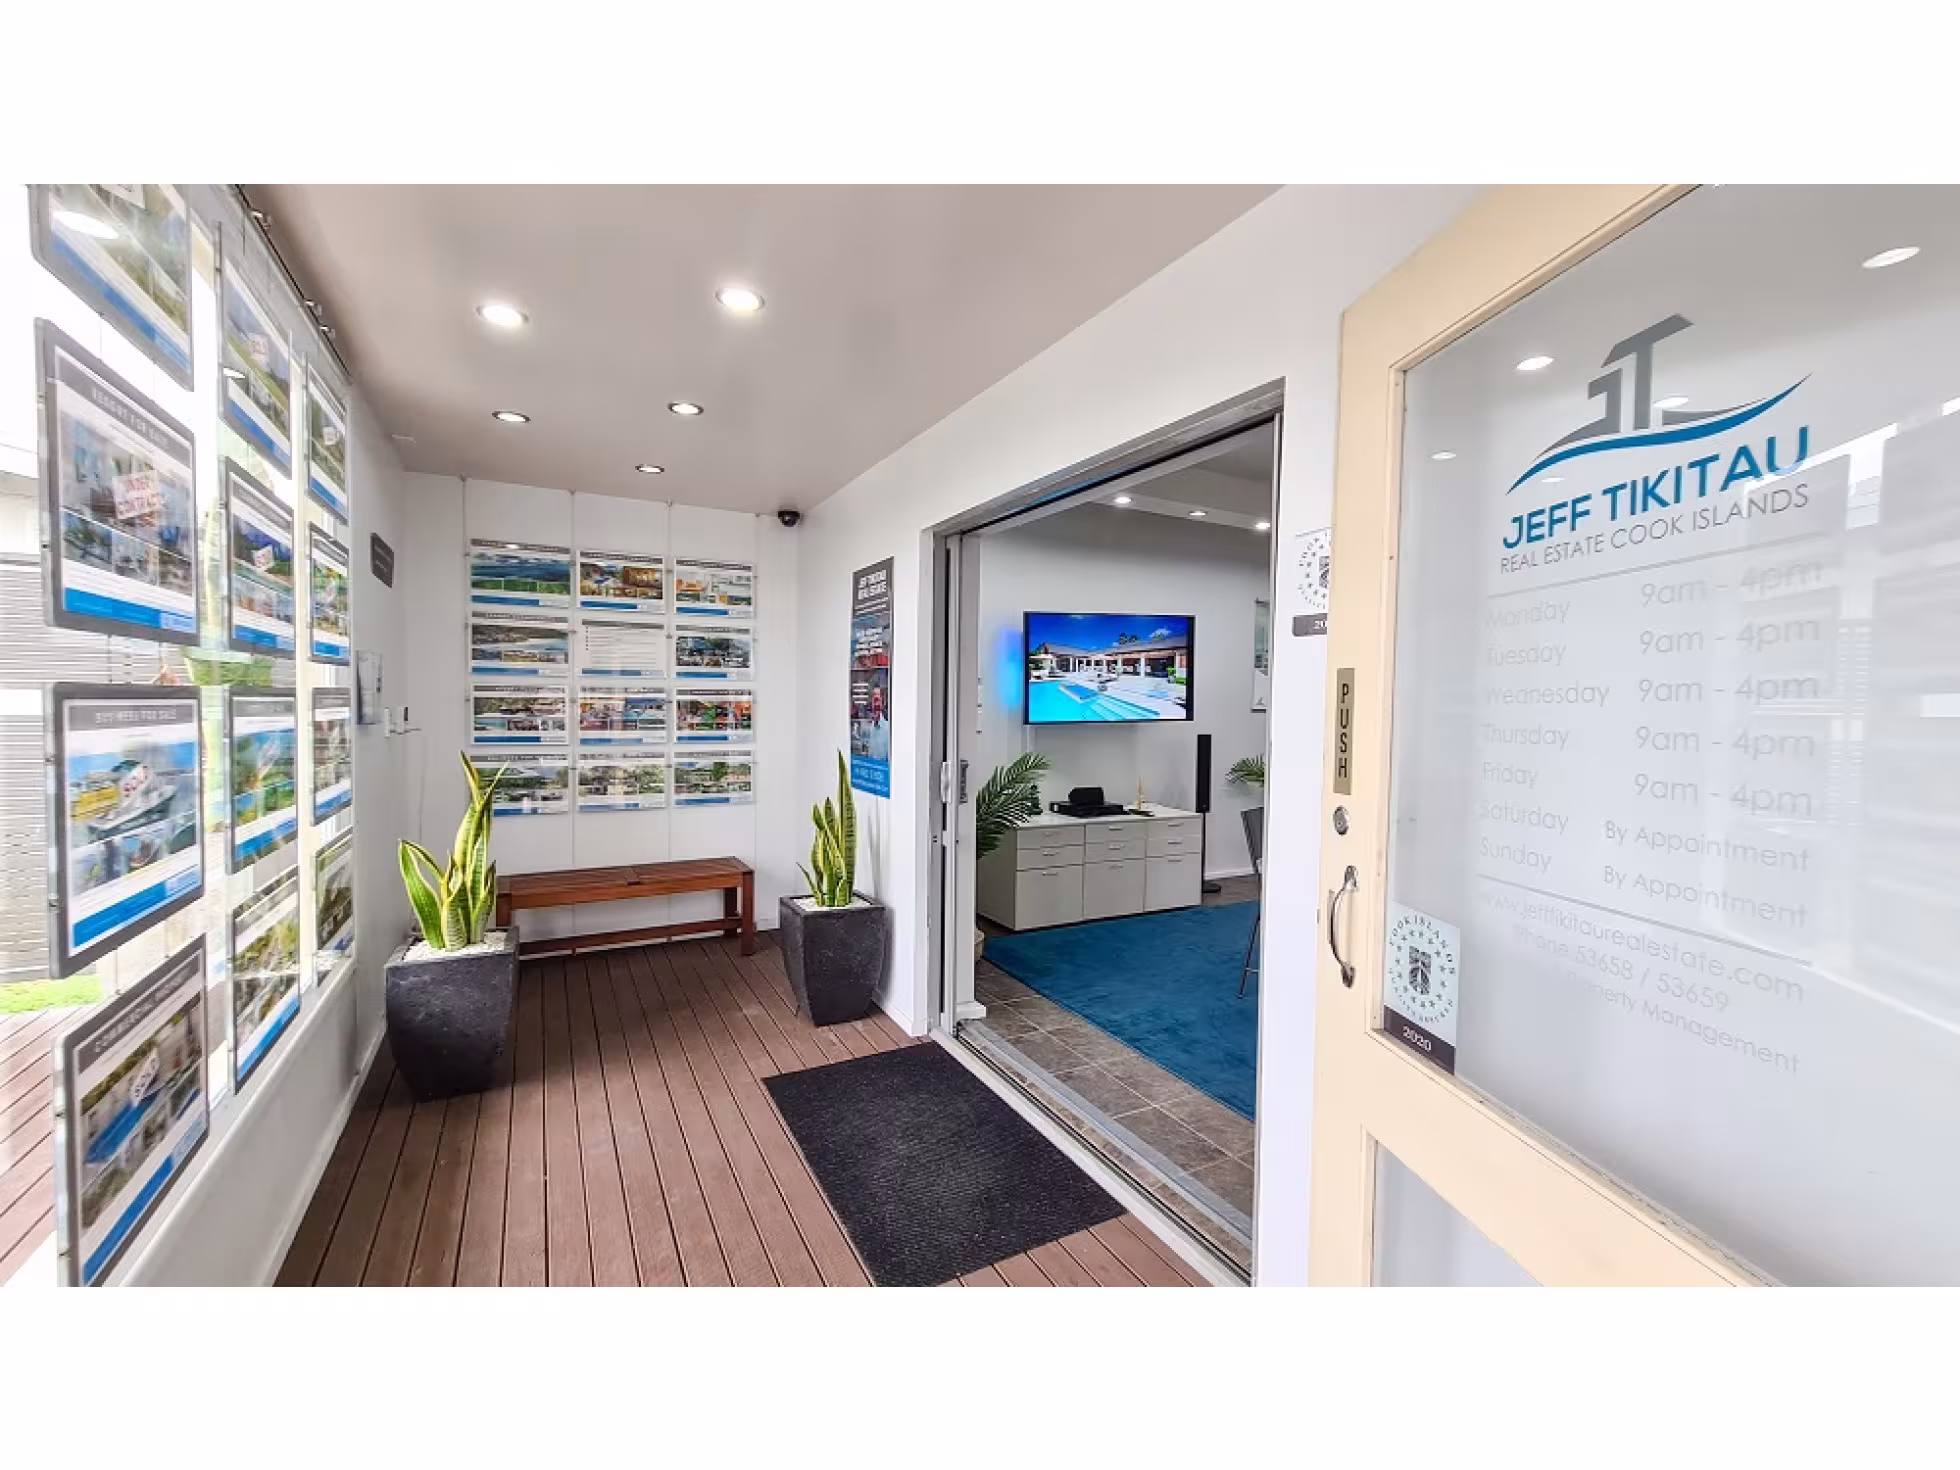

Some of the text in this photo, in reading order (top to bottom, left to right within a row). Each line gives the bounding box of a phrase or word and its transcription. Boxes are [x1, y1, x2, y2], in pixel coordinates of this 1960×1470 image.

[1502, 424, 1810, 549] JEFF TIKITAU
[1500, 483, 1809, 574] REAL ESTATE COOK ISLANDS
[1478, 599, 1571, 629] Monday
[1640, 579, 1707, 608] 9am
[1739, 560, 1825, 597] 4pm
[1486, 641, 1567, 667] Tuesday
[1639, 628, 1705, 655] 9am
[1736, 618, 1820, 653] 4pm
[1485, 680, 1612, 708] Wednesday
[1638, 677, 1704, 703] 9am
[1733, 672, 1821, 706] 4pm
[1337, 683, 1350, 779] PUSH
[1479, 721, 1571, 752] Thursday
[1634, 725, 1700, 753] 9am
[1731, 727, 1816, 761] 4pm
[1480, 761, 1540, 790] Friday
[1633, 772, 1699, 804] 9am
[1729, 783, 1813, 817] 4pm
[1478, 799, 1814, 873] Saturday By Appointment
[1479, 834, 1809, 929] Sunday By Appointment
[1478, 893, 1806, 1004] ww.jefftikitaurealestate.com
[1574, 945, 1634, 981] 53658
[1656, 971, 1730, 1014] 53659
[1402, 1025, 1432, 1052] 2020
[1642, 998, 1800, 1077] Management
